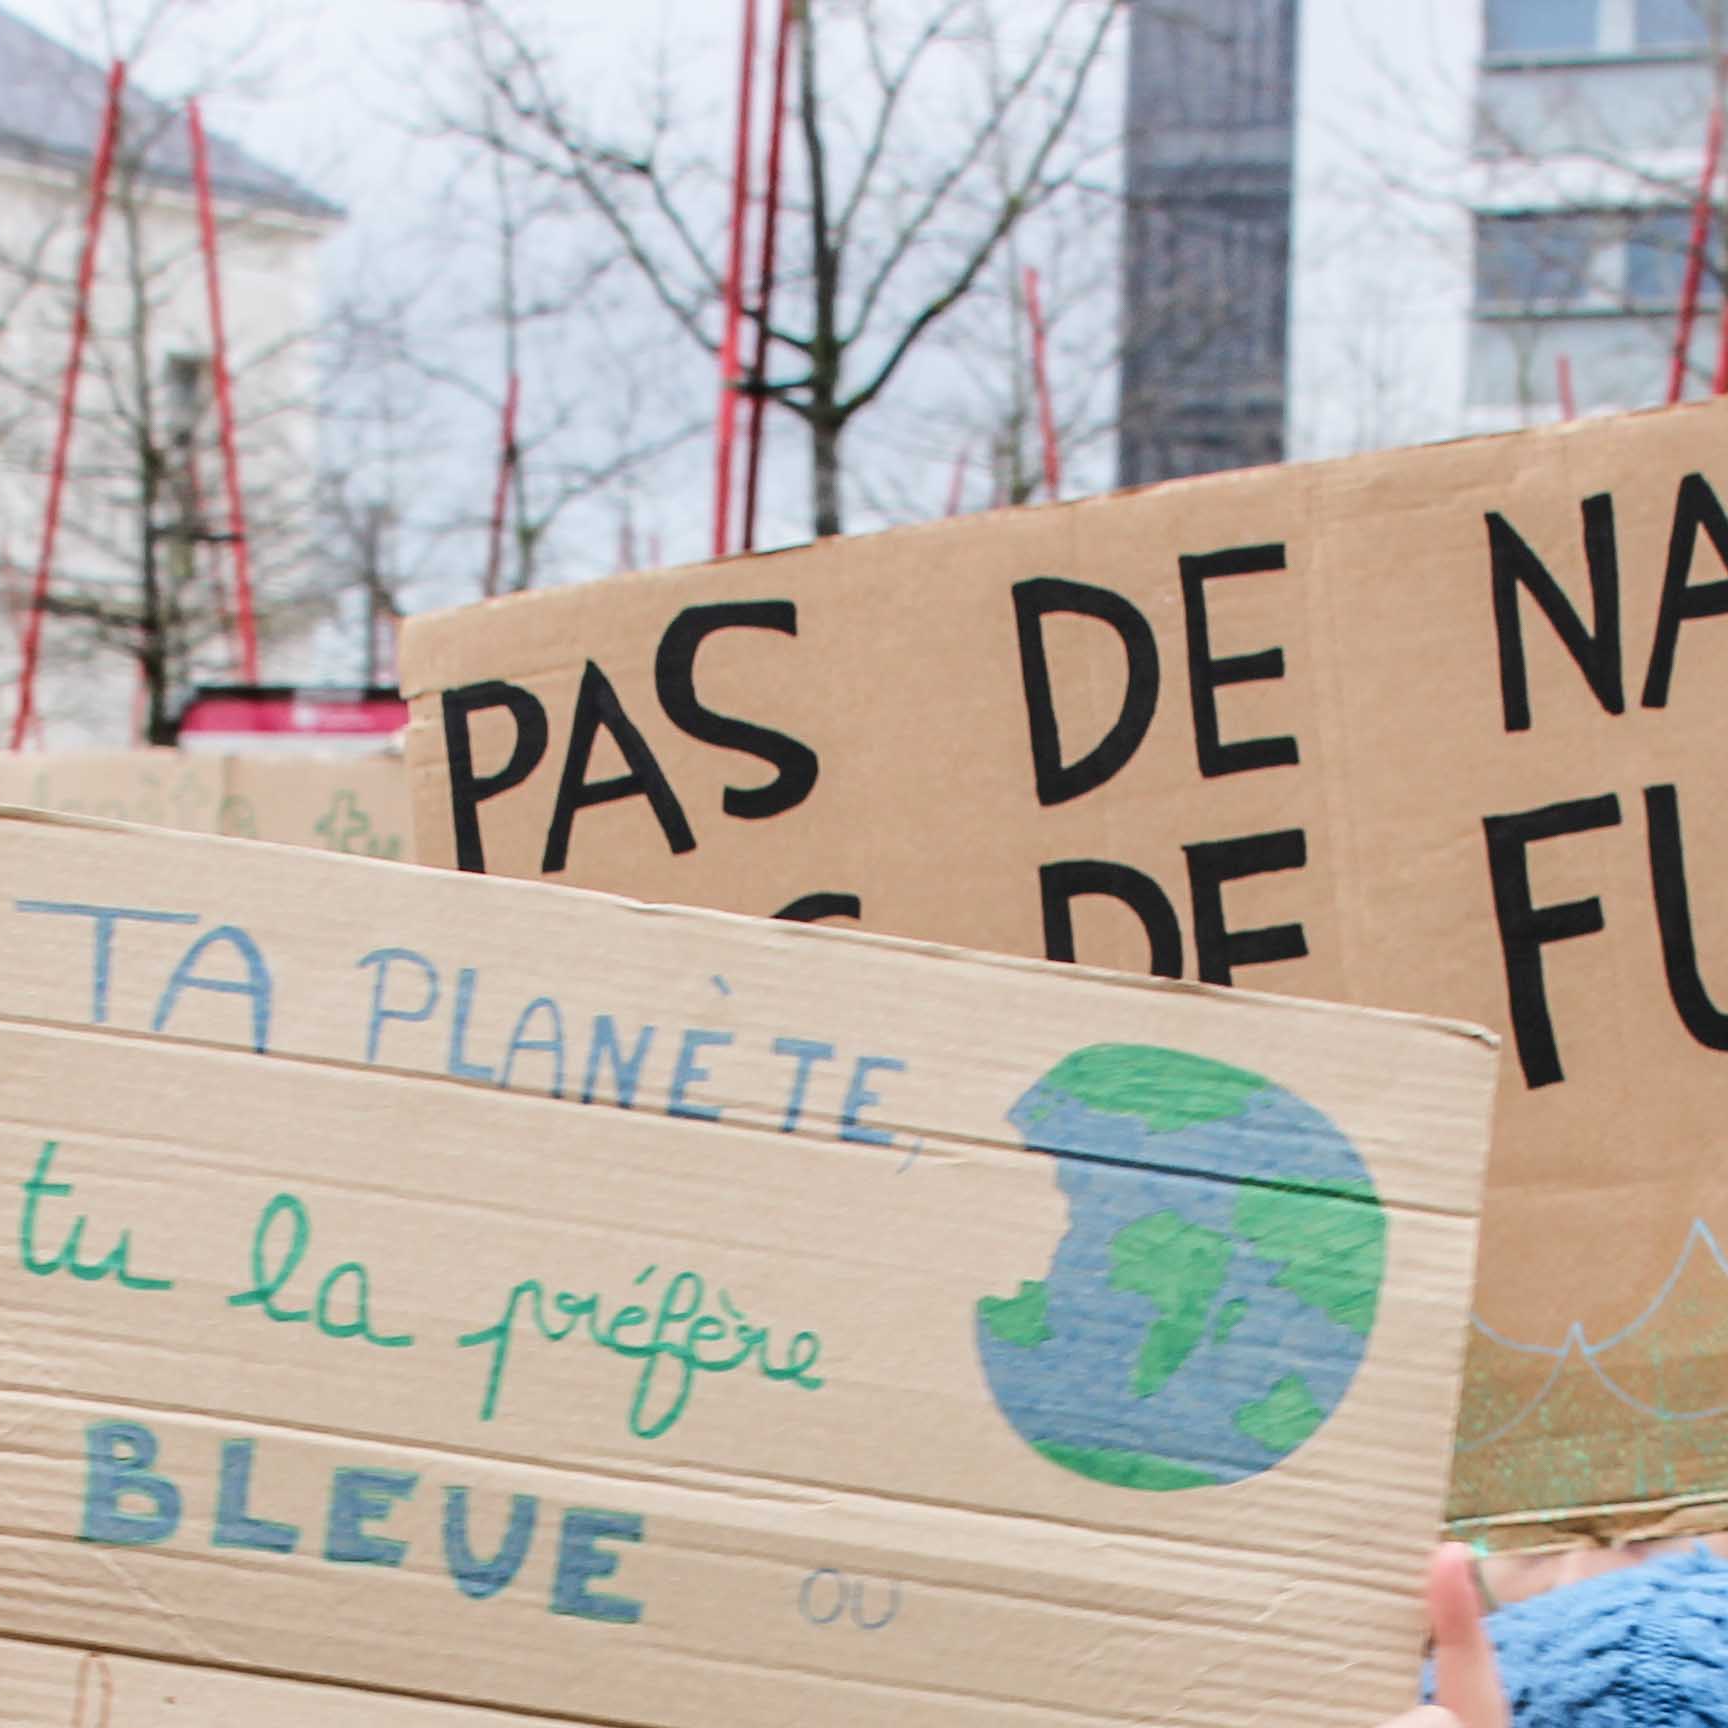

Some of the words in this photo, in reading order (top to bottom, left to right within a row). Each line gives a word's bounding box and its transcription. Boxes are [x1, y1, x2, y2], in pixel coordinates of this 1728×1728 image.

[441, 600, 819, 873] PAS
[1012, 542, 1300, 807] DE
[15, 900, 273, 1055] TA
[1039, 828, 1309, 986] DE
[18, 1140, 173, 1291] tu
[229, 1193, 414, 1347] la
[461, 1266, 824, 1439] préfère
[81, 1420, 647, 1626] BLEUE
